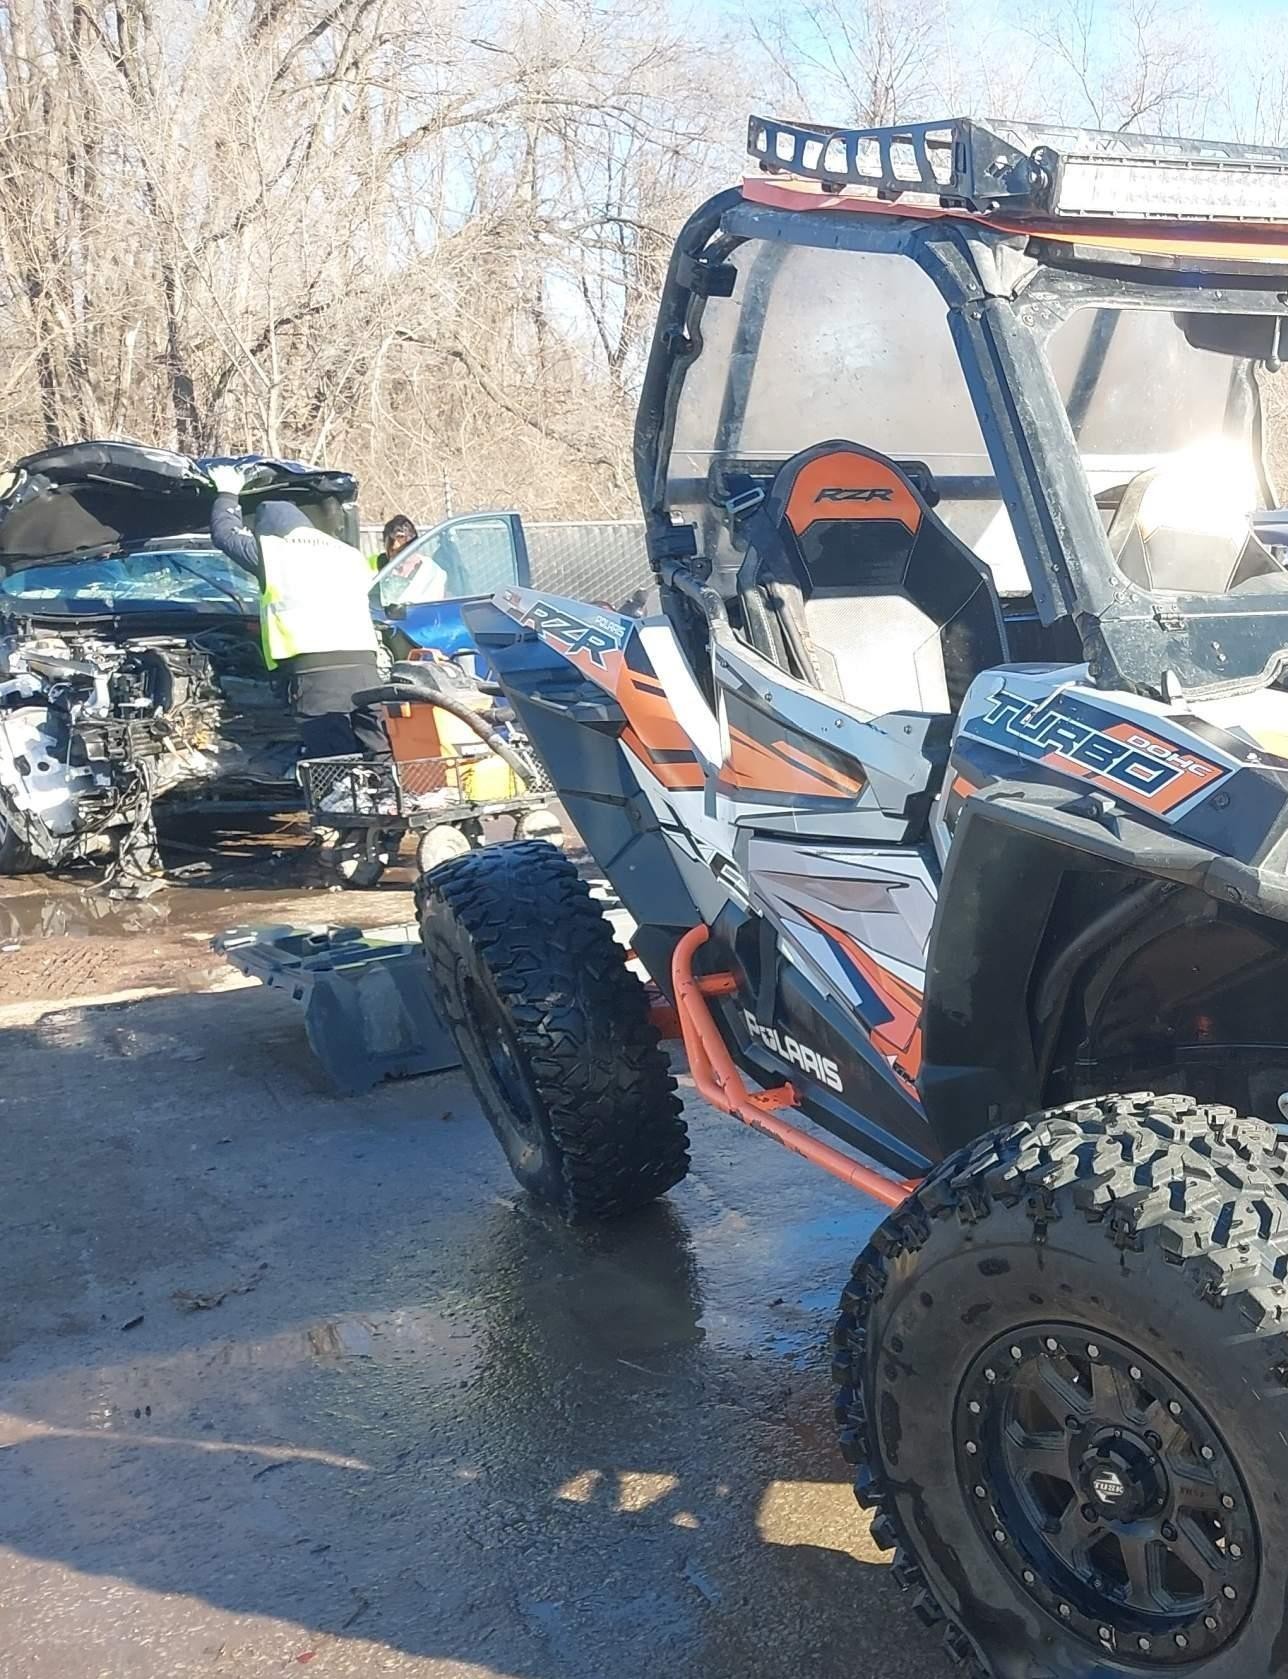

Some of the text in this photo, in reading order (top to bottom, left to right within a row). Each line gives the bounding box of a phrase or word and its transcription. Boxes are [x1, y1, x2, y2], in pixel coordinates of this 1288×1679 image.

[814, 488, 894, 503] RZR
[519, 599, 620, 672] RZR
[595, 615, 625, 641] POLARIS
[984, 689, 1185, 798] TURBO
[1126, 735, 1214, 777] DOHC
[743, 1008, 844, 1093] POLARIS
[1094, 1482, 1125, 1494] TUSK
